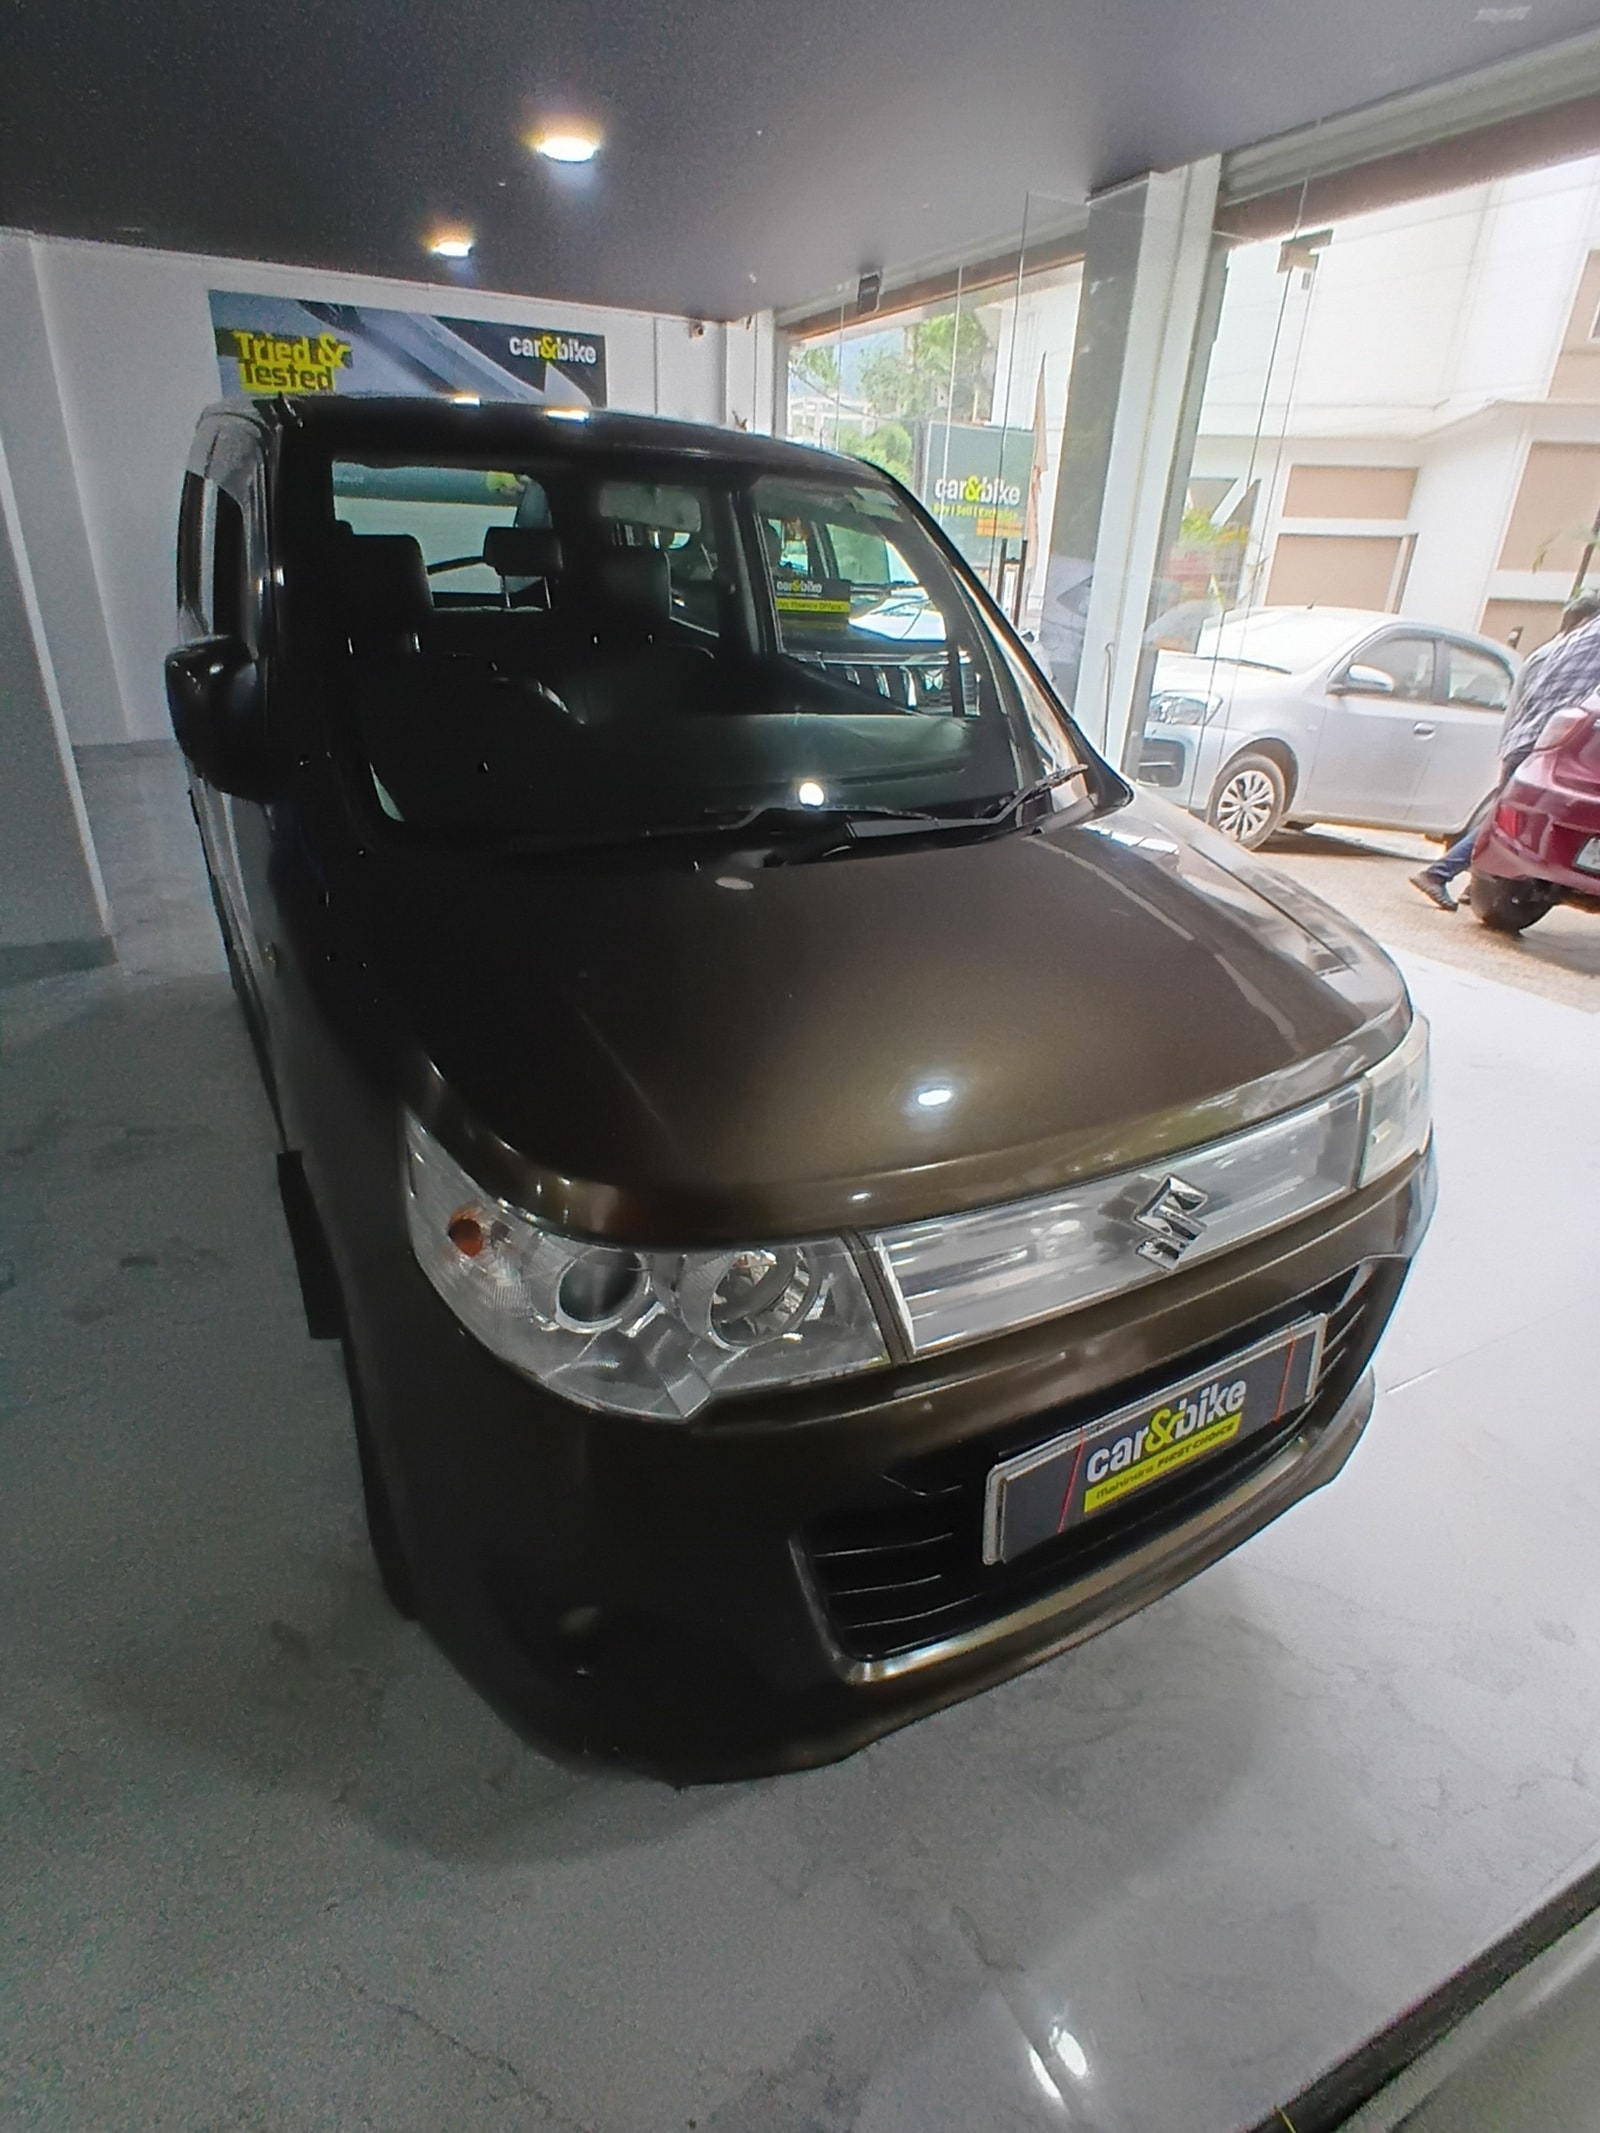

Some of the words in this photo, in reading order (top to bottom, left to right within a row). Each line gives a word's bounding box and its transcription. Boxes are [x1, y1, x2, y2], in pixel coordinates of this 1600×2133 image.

[233, 330, 311, 363] Tried
[318, 333, 351, 368] &
[509, 336, 597, 364] car&bike
[238, 359, 334, 390] Tested
[934, 476, 1020, 506] car&bike
[1086, 1380, 1247, 1483] car&bike
[1096, 1465, 1153, 1499] Mahindra
[1157, 1444, 1192, 1467] FIRST
